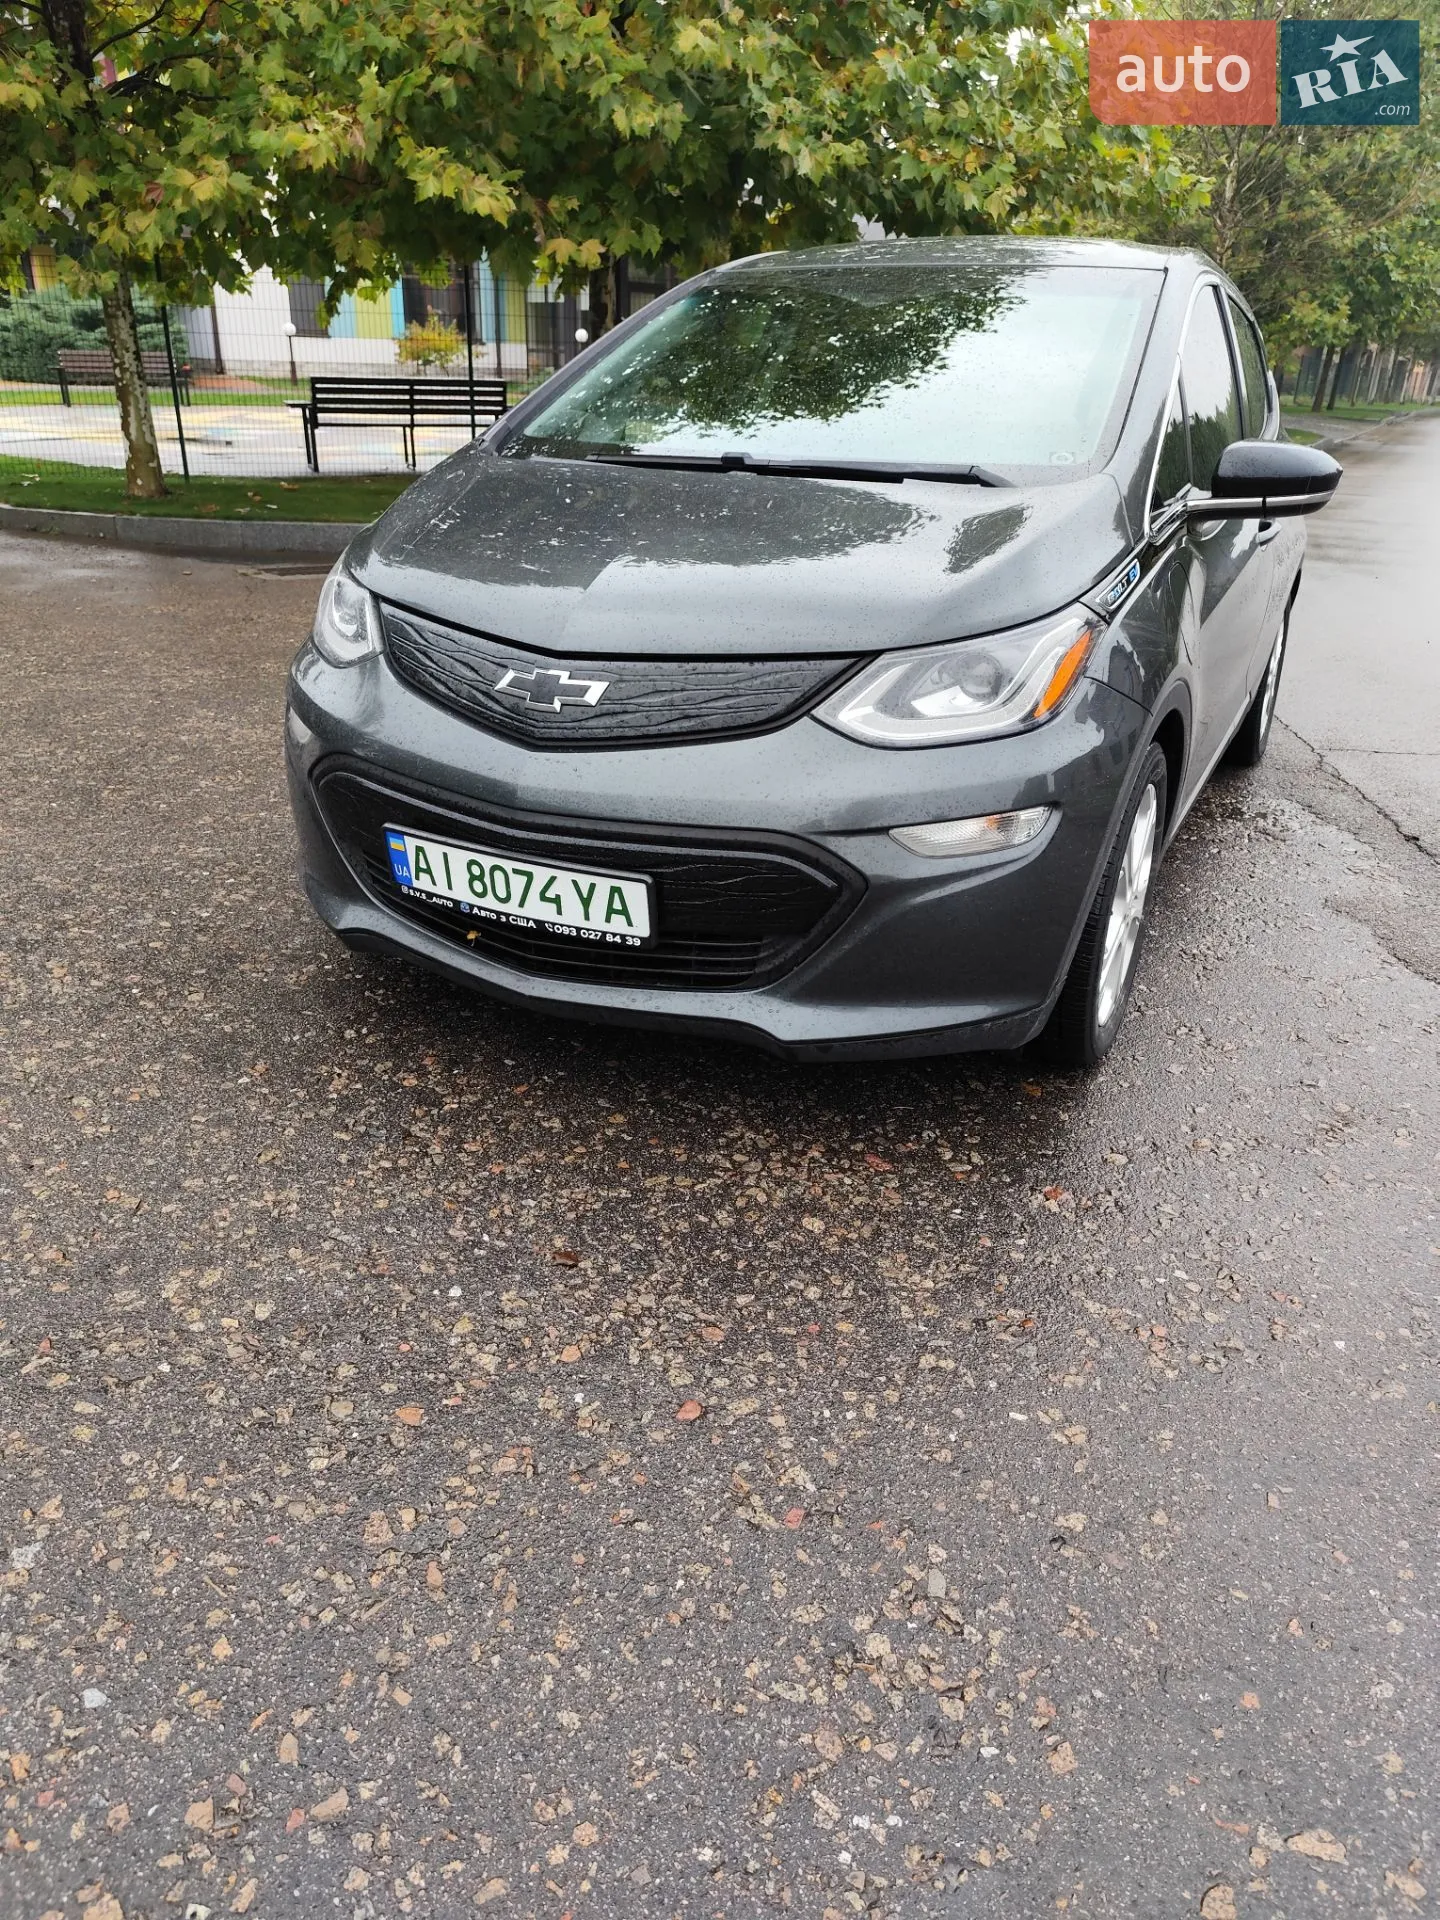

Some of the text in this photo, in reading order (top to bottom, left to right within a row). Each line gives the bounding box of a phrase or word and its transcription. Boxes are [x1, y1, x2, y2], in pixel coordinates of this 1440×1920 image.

[394, 863, 411, 879] UA
[414, 844, 454, 891] AI
[508, 915, 537, 929] США
[554, 924, 641, 946] 093 027 84 39
